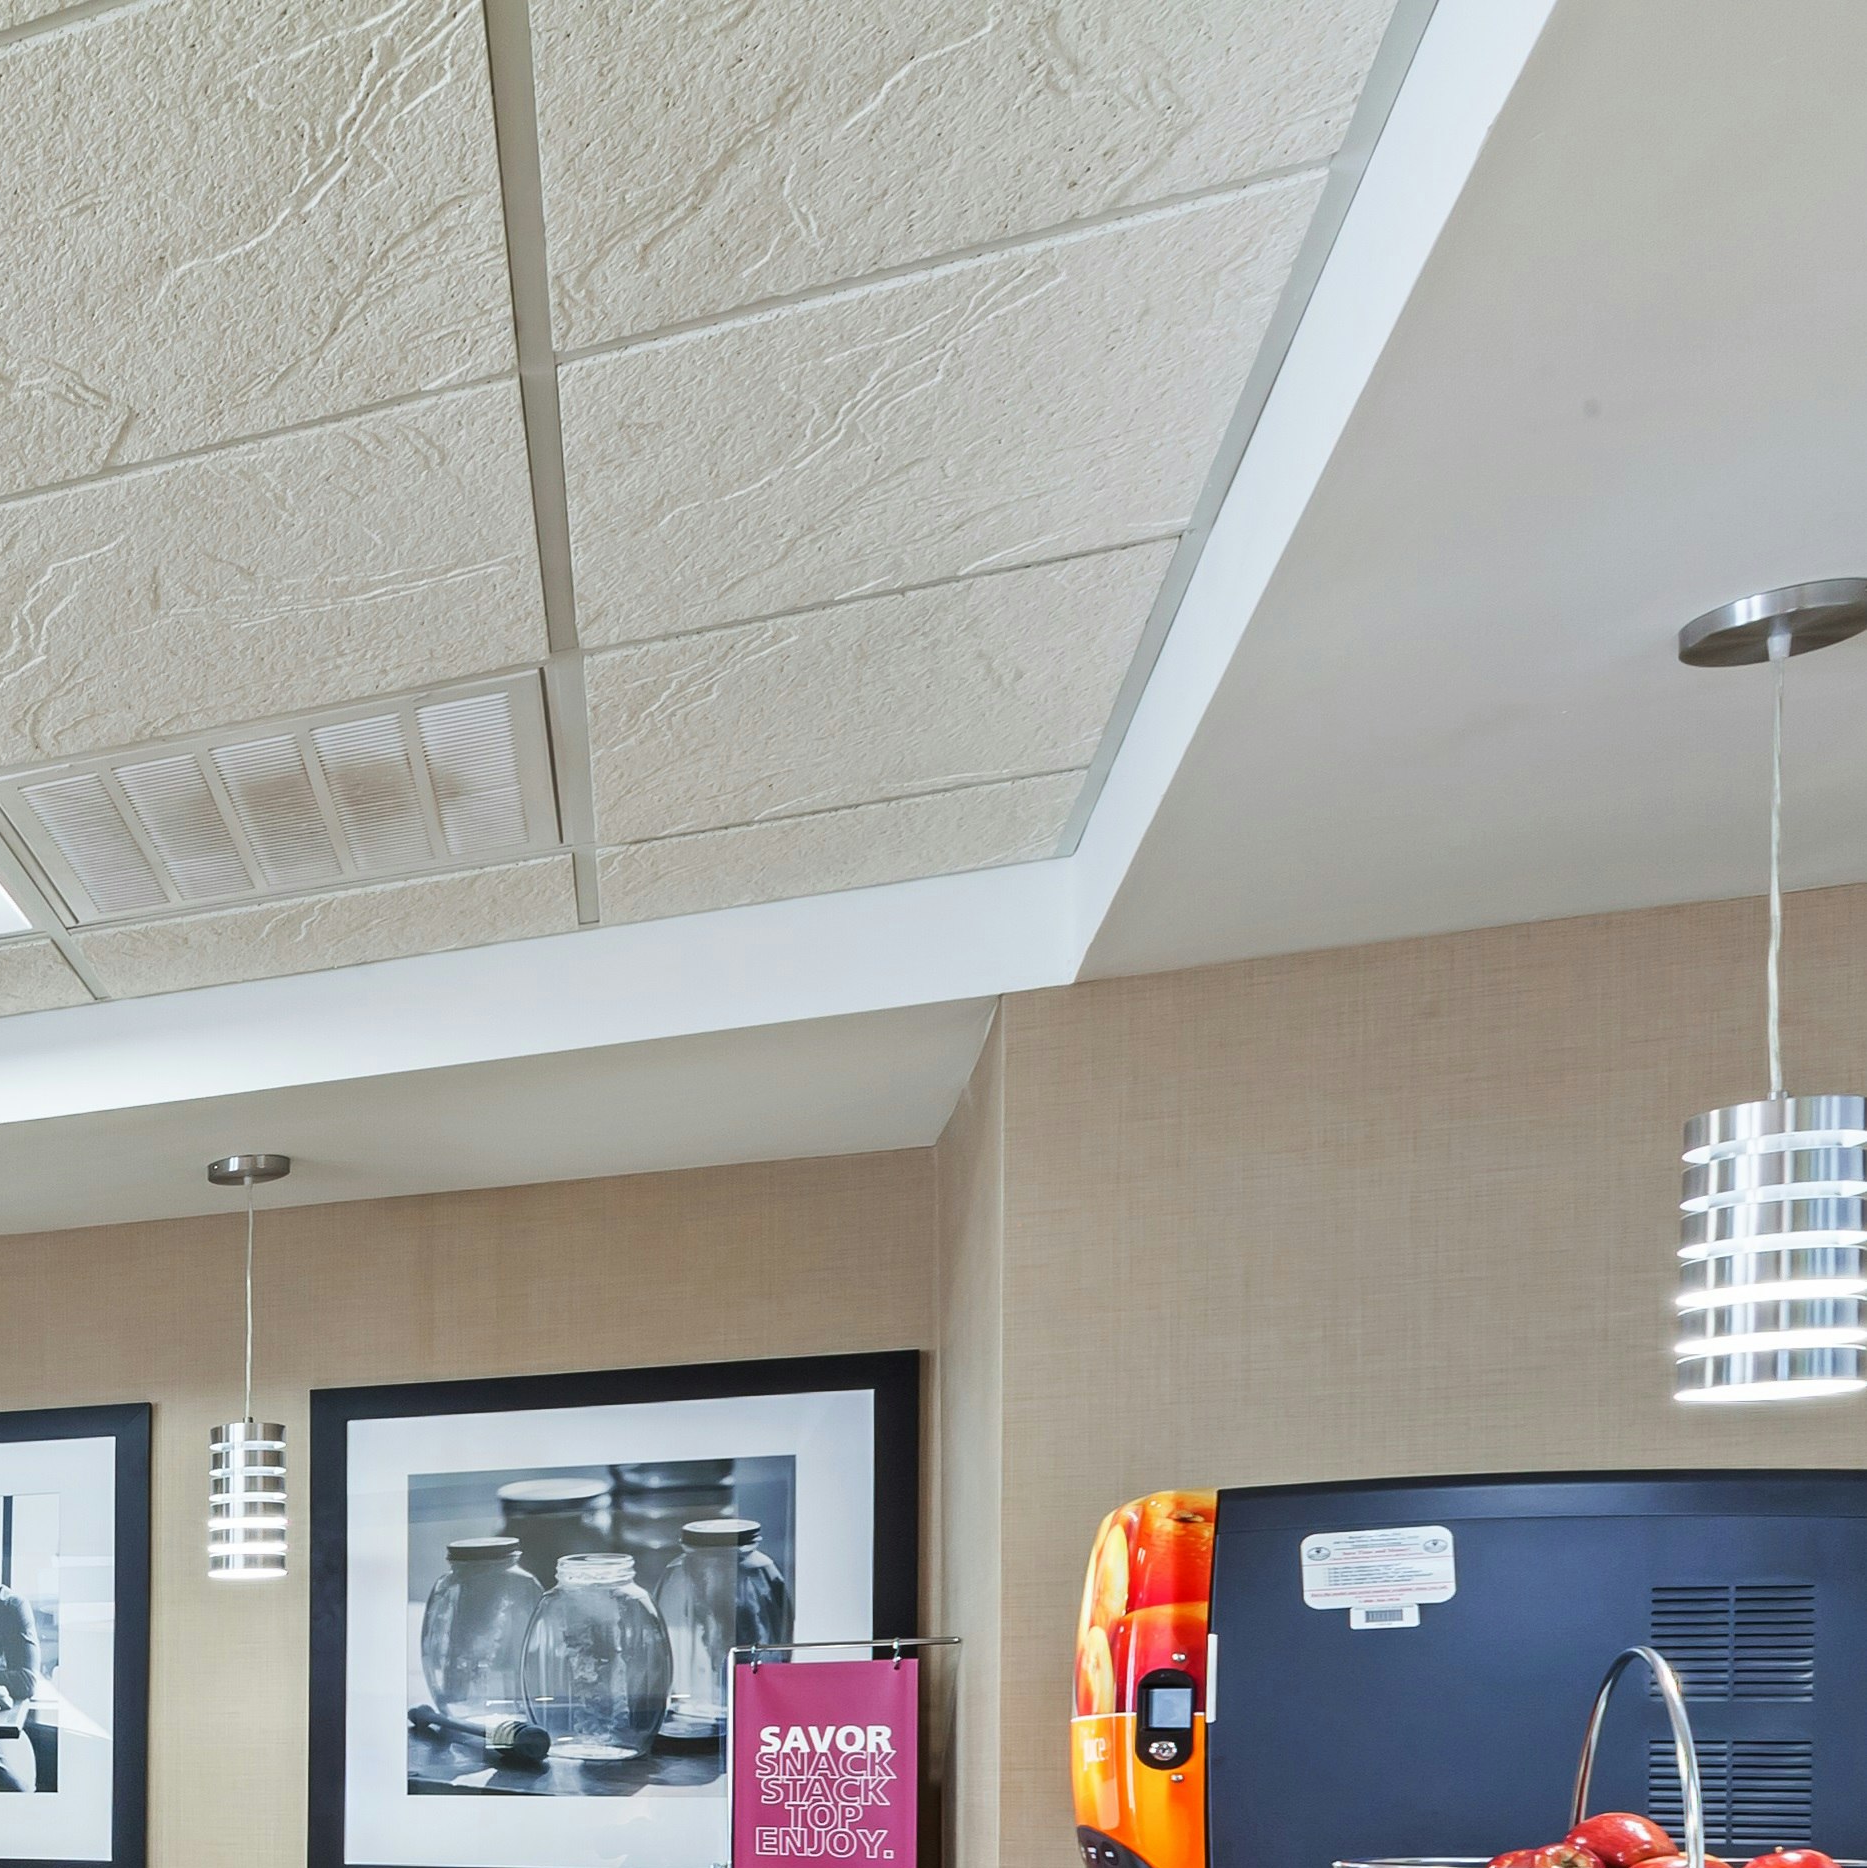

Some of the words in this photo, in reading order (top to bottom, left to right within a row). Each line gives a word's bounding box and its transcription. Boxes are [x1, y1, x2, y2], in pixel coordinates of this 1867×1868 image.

[760, 1725, 893, 1753] SAVOR
[755, 1750, 897, 1779] SNACK
[760, 1775, 891, 1806] STACK
[784, 1801, 863, 1831] TOP
[755, 1826, 895, 1860] ENJOY.
